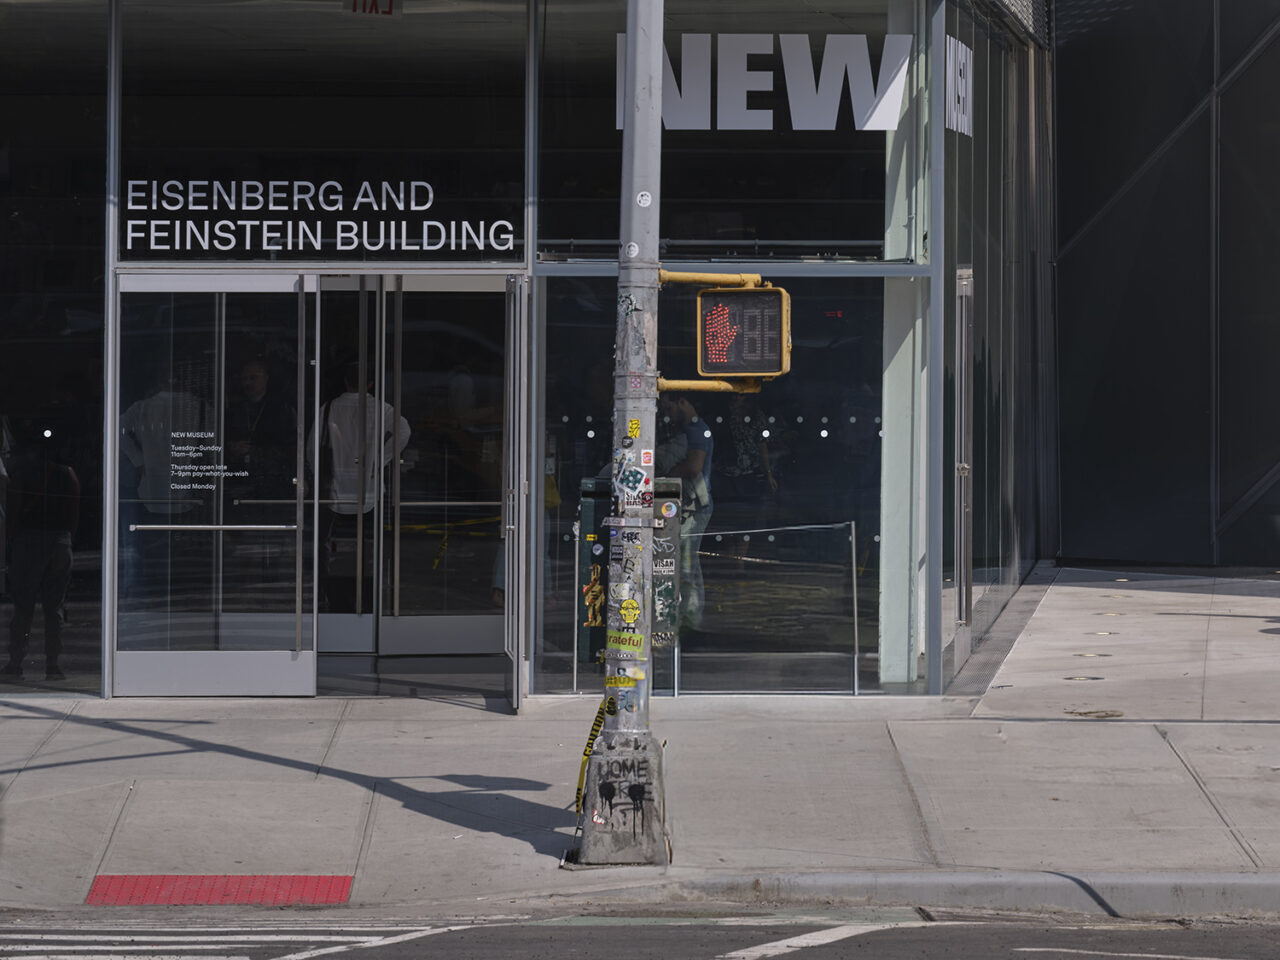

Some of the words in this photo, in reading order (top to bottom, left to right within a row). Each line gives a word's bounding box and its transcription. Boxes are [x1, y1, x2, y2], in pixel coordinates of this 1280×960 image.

[616, 34, 913, 130] NEW
[127, 180, 343, 211] EISENBERG
[353, 181, 434, 211] AND
[126, 219, 322, 251] FEINSTEIN
[336, 220, 515, 251] BUILDING
[192, 483, 216, 491] Monday
[607, 635, 643, 648] rateful
